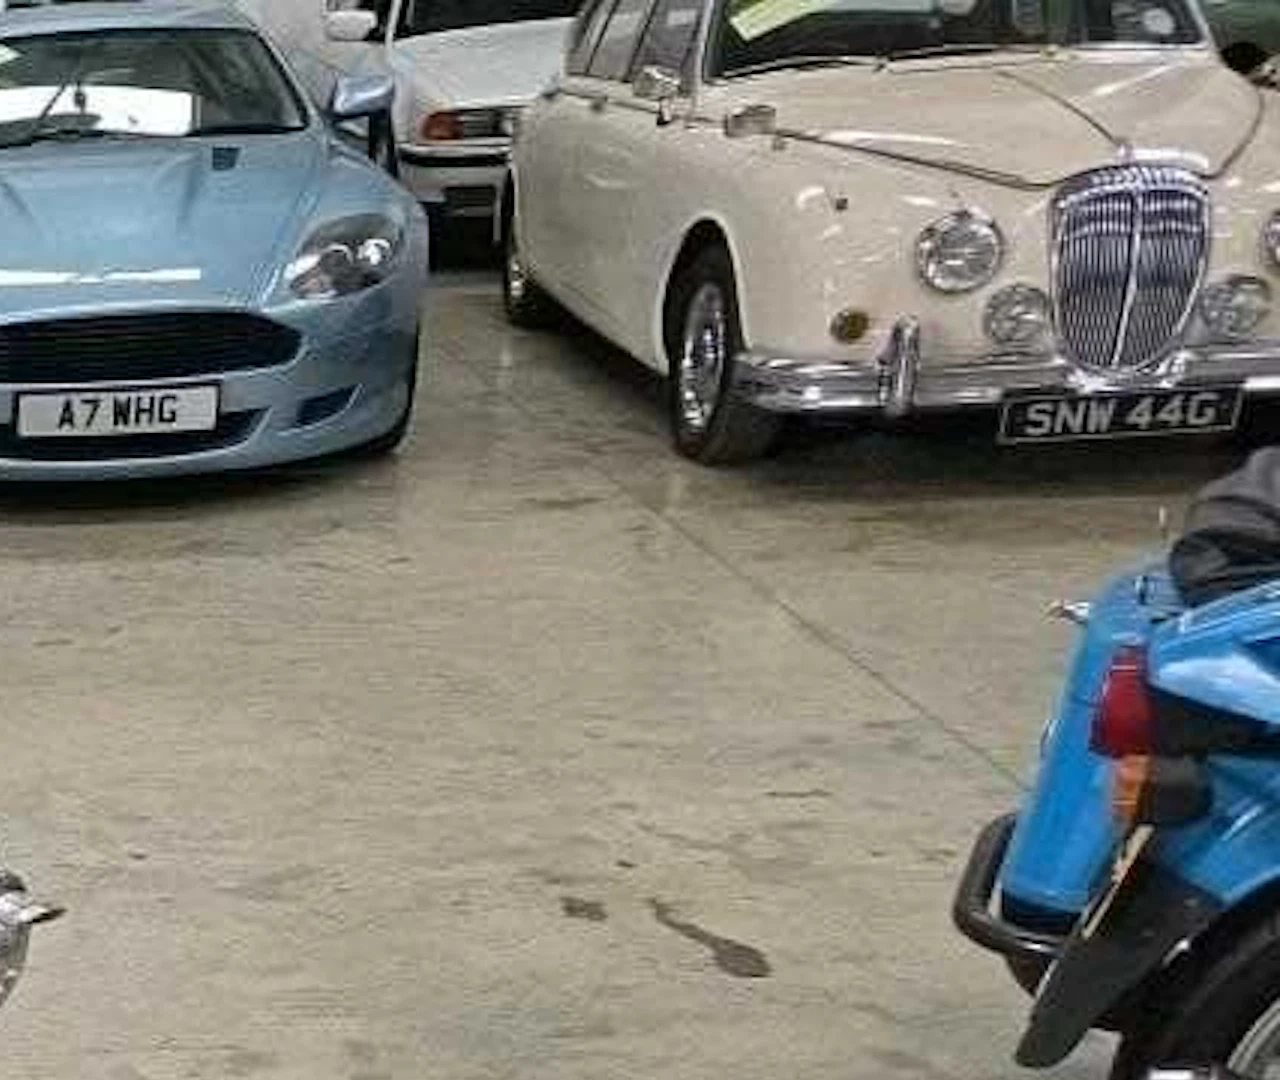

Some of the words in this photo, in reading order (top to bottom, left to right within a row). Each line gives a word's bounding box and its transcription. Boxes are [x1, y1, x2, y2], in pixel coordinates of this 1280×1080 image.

[58, 398, 102, 429] A7
[1024, 399, 1117, 436] SNW
[1125, 392, 1220, 431] 44G
